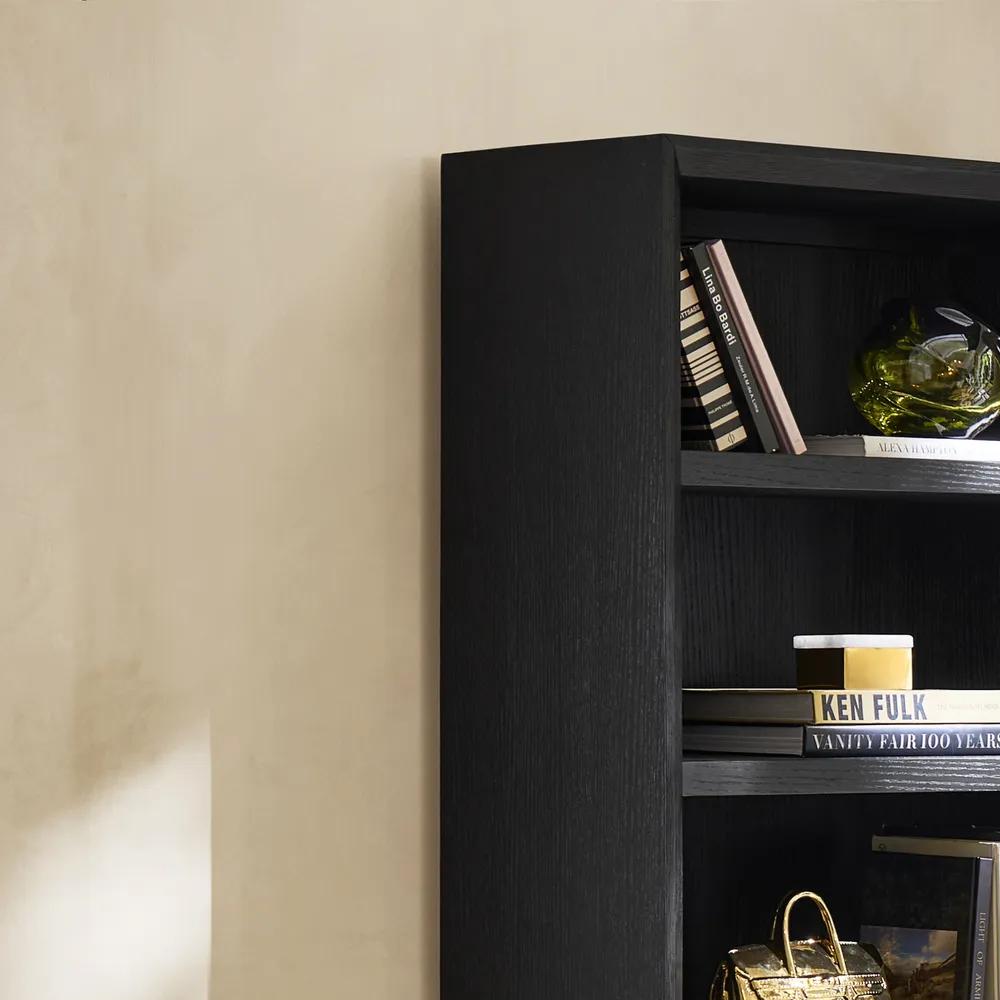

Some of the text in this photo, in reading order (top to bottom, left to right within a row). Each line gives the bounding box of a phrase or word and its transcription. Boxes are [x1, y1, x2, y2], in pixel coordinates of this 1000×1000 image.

[702, 266, 737, 346] Lina Bo Bardi
[821, 694, 927, 721] KEN FULK
[812, 734, 874, 750] VANITY
[880, 733, 917, 750] FAIR
[978, 912, 987, 943] LIGHT
[976, 951, 985, 966] OF
